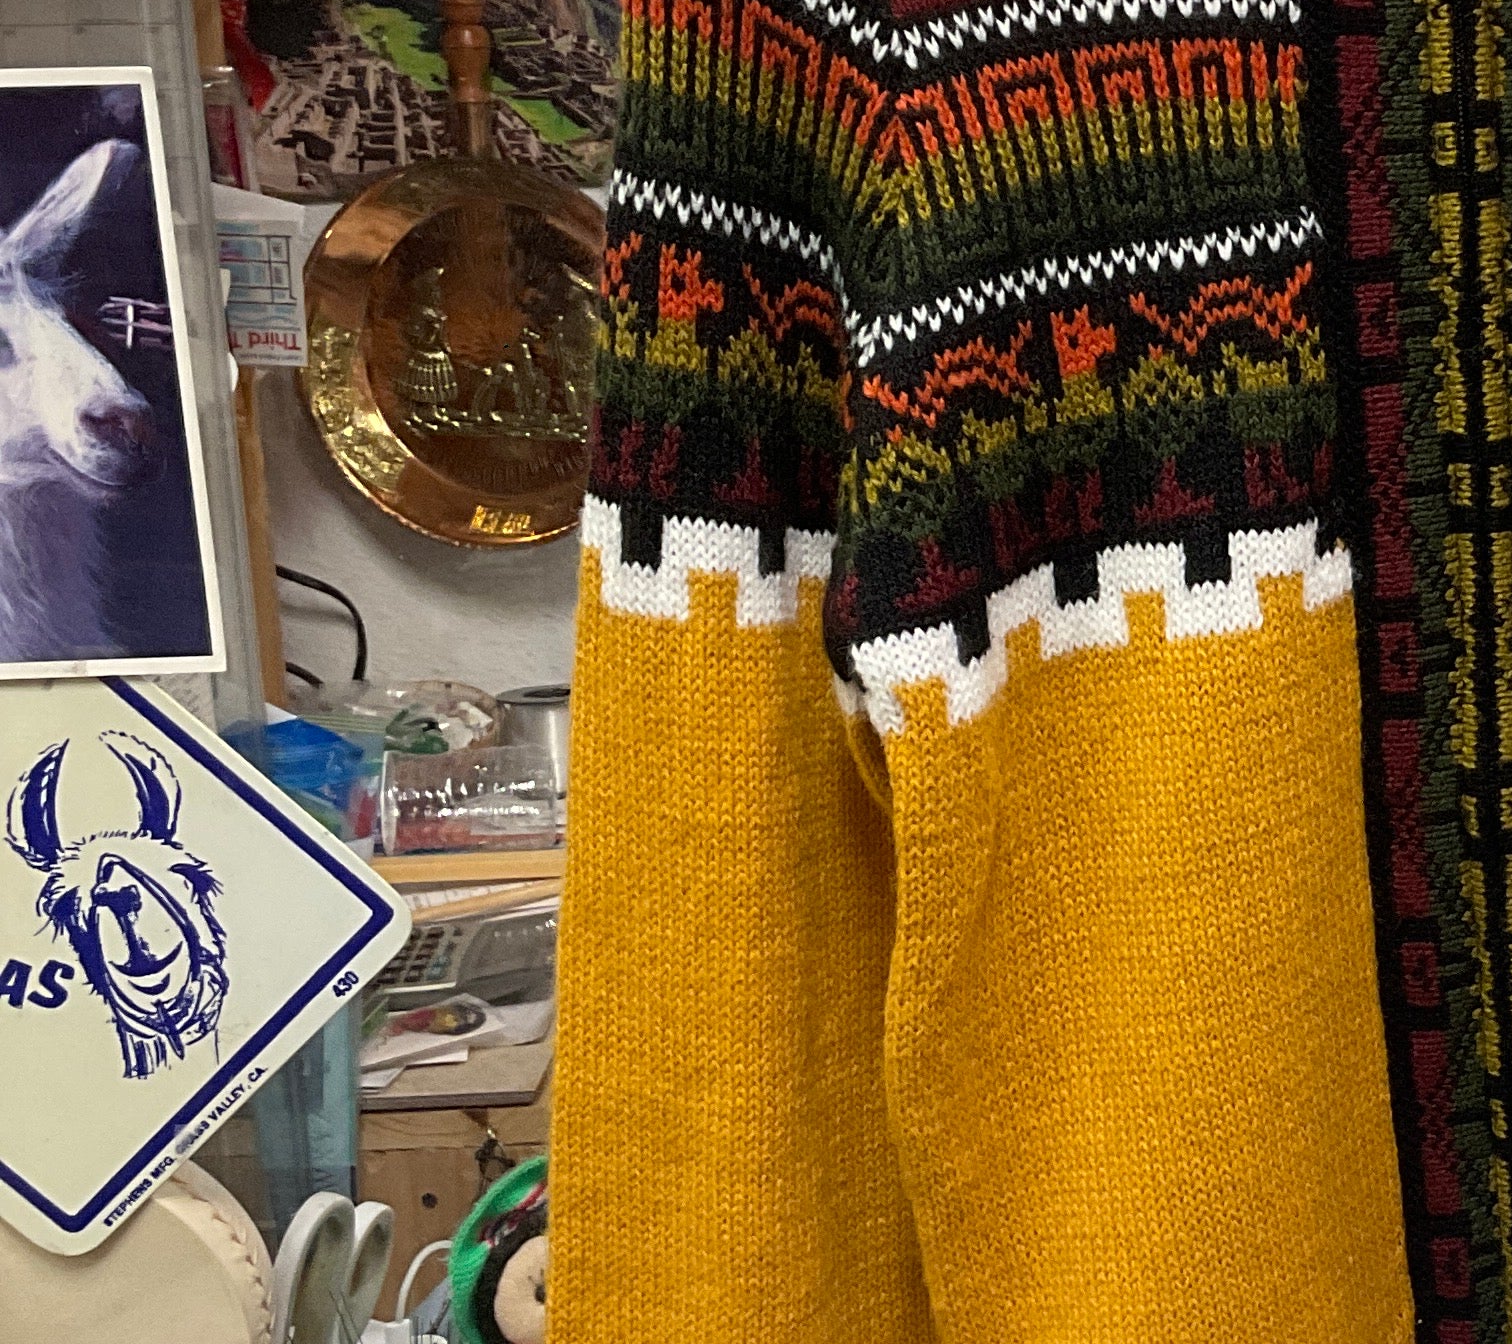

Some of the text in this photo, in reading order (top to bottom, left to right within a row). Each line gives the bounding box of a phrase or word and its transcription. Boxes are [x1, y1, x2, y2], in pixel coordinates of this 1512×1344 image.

[248, 331, 302, 351] Third
[0, 958, 75, 1009] AS
[332, 970, 359, 998] 430
[103, 1178, 153, 1228] STEPHENS
[150, 1156, 177, 1180] MFG.
[247, 1066, 269, 1084] CA.
